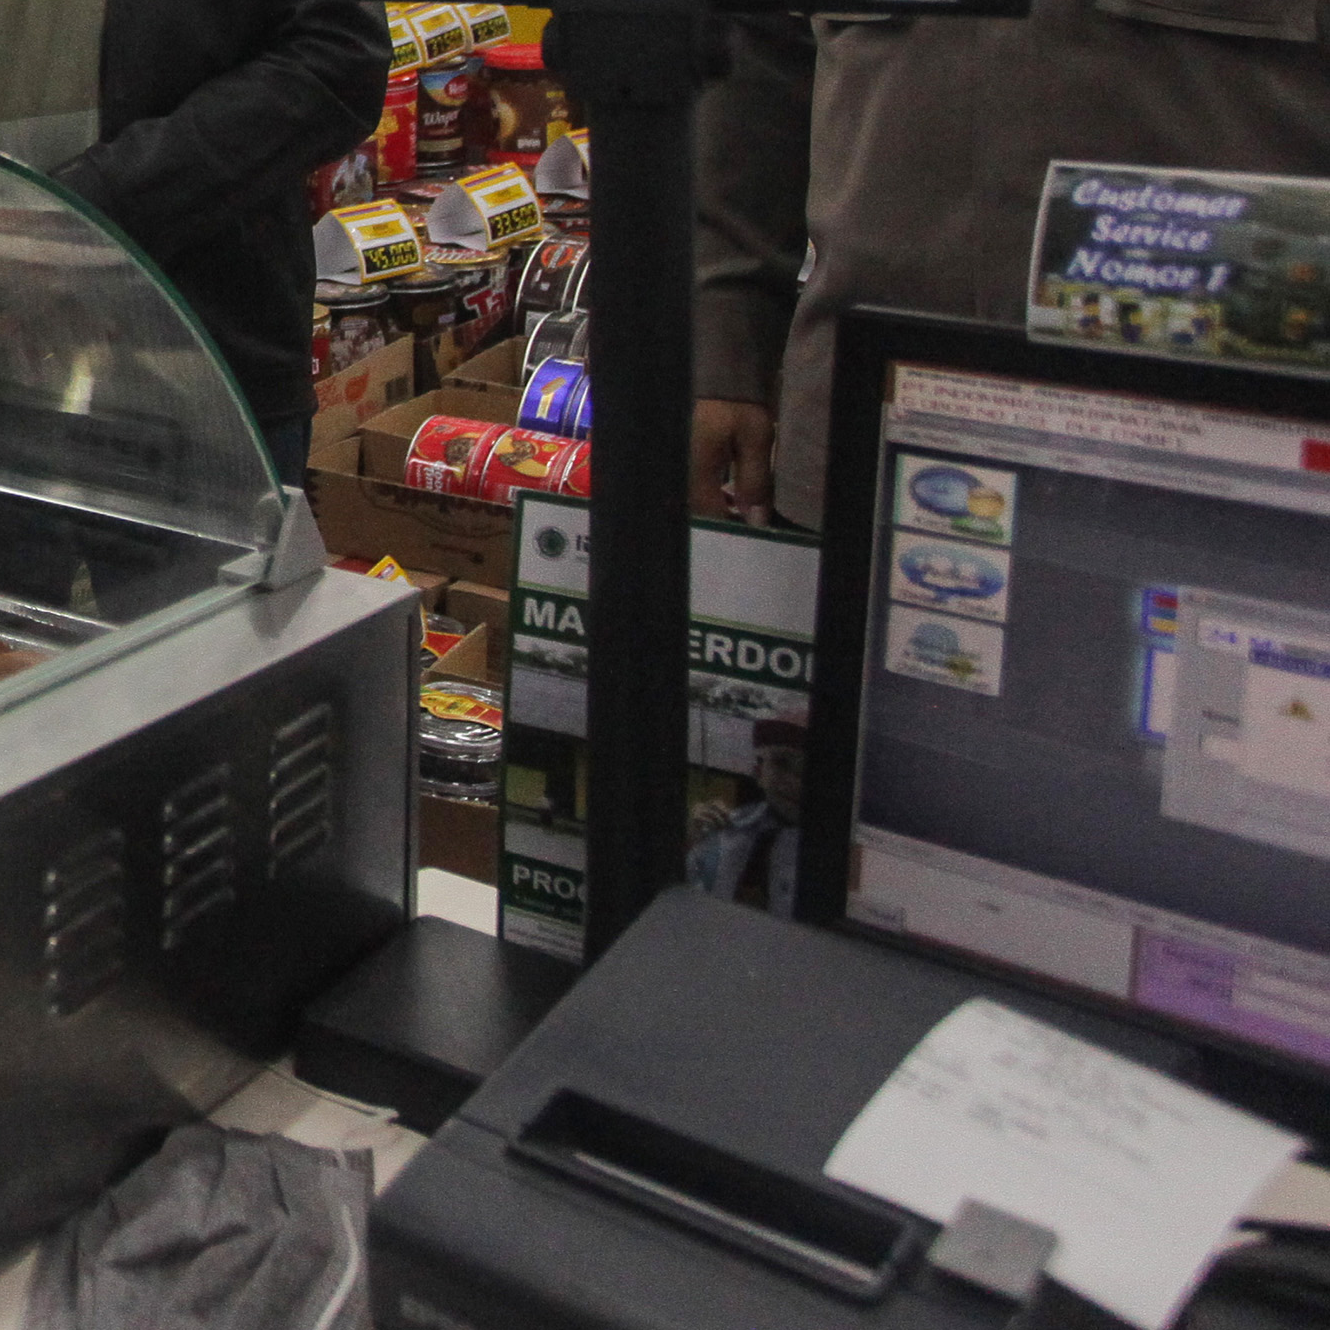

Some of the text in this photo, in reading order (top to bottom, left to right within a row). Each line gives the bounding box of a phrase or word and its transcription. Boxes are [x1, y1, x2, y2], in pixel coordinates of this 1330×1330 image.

[1072, 179, 1246, 219] Customer
[495, 205, 537, 235] 33.500
[1091, 215, 1212, 253] Service
[370, 243, 418, 268] 45.000
[1066, 249, 1200, 288] Nomor
